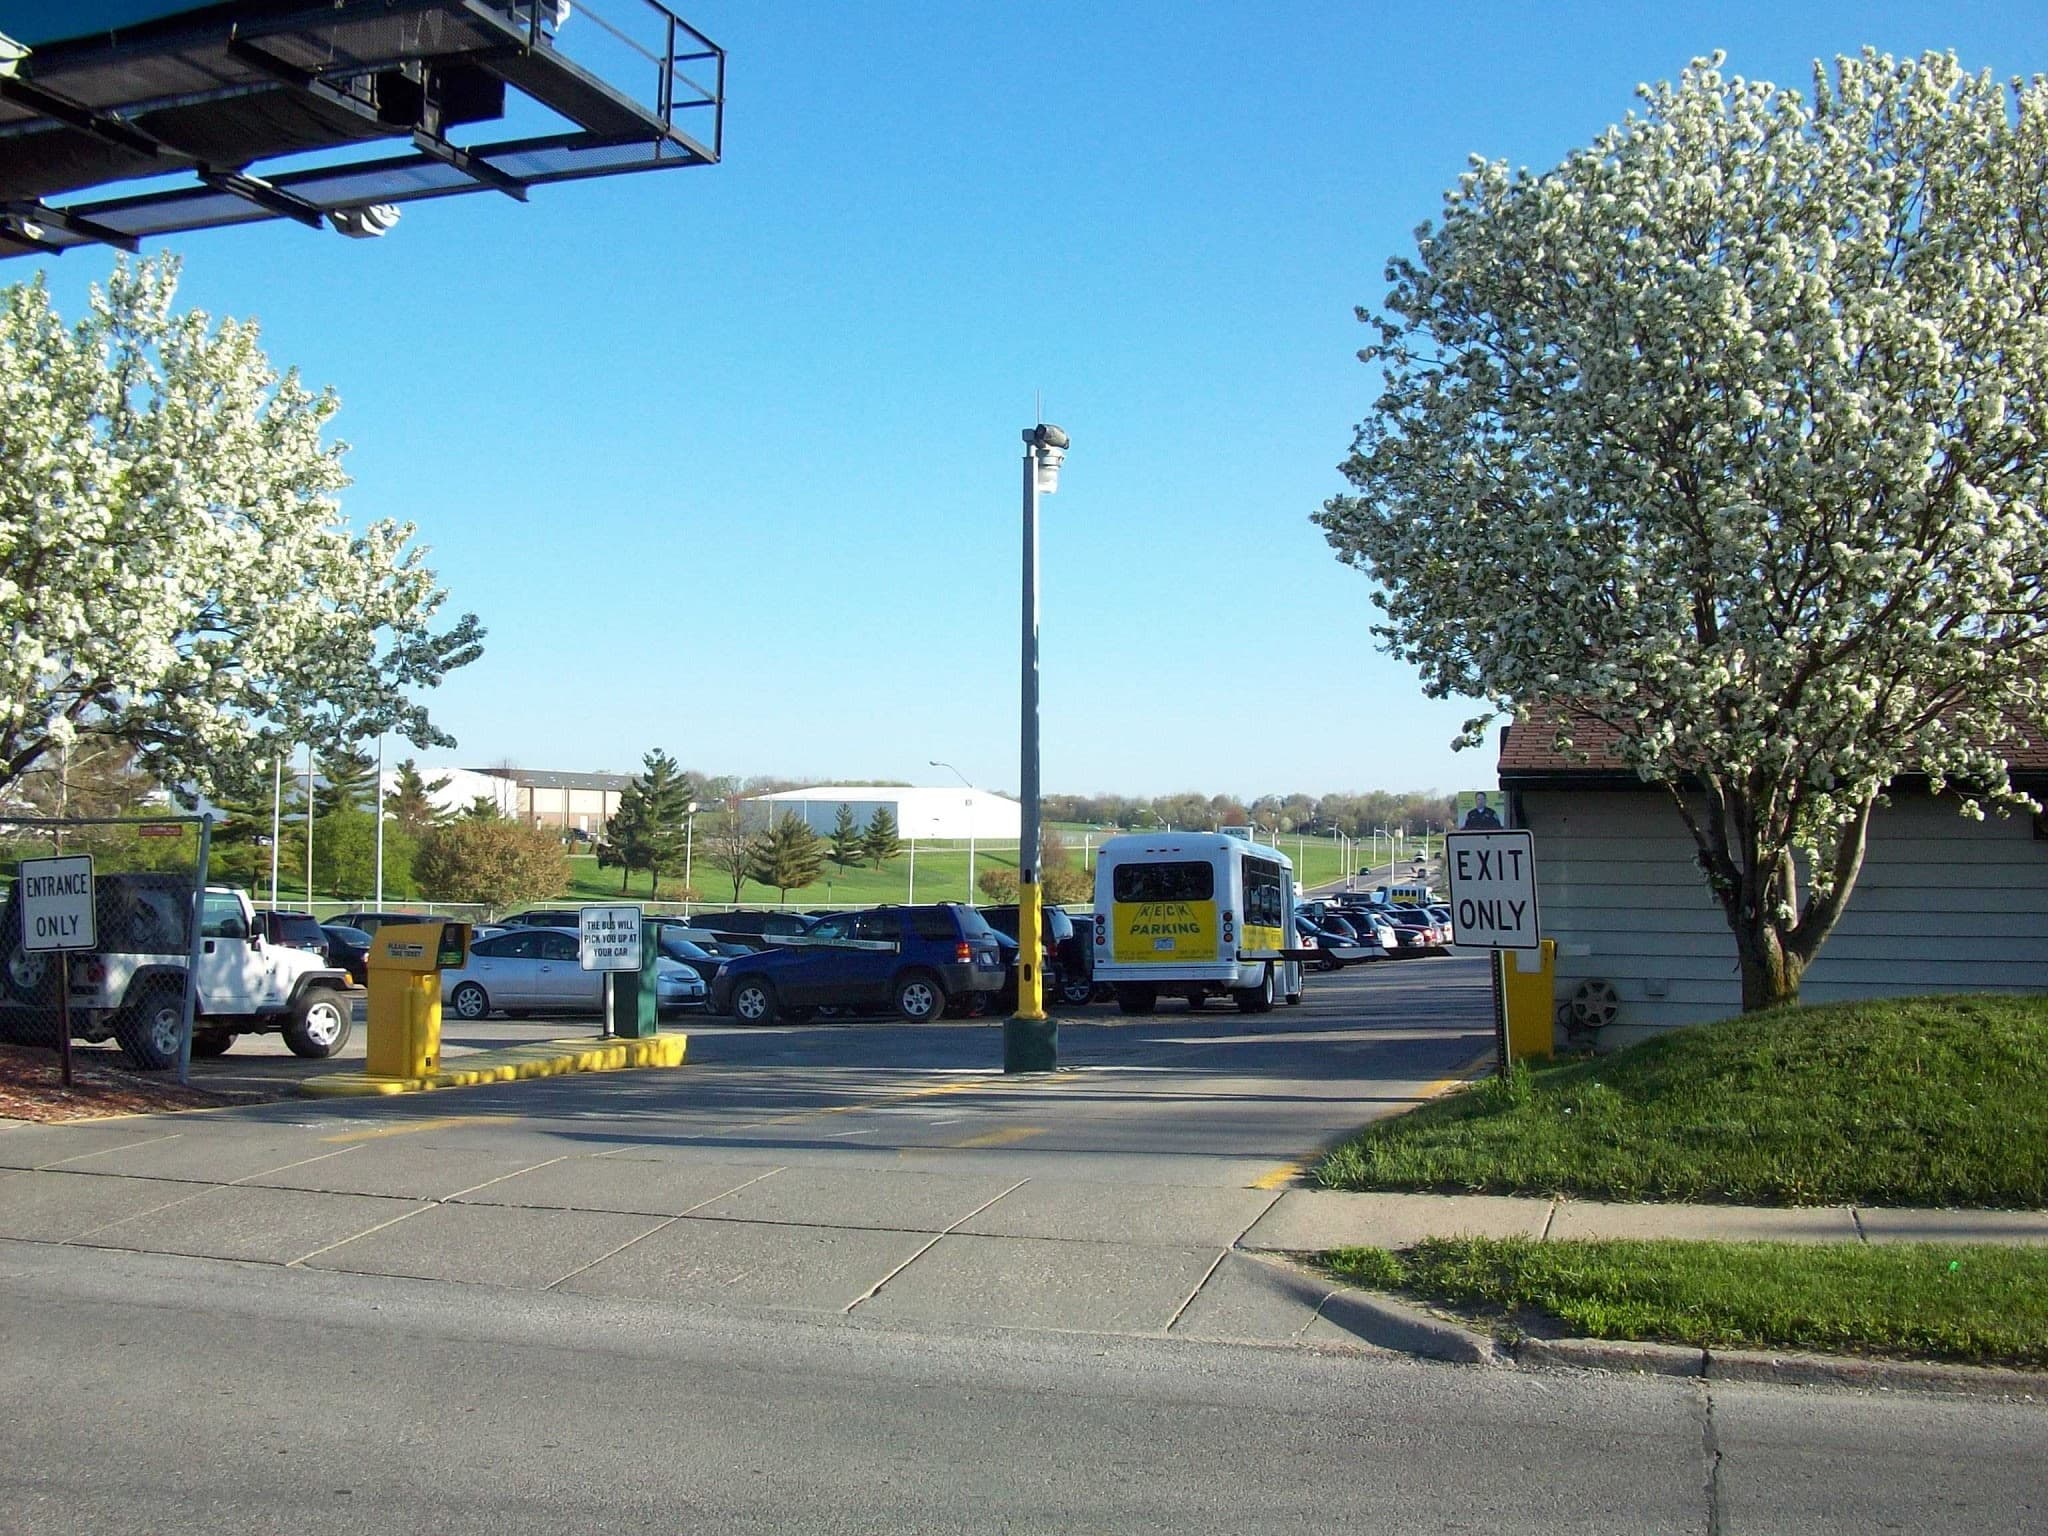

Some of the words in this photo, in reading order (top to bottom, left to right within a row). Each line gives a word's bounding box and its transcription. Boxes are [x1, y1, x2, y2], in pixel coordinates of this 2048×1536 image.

[1457, 850, 1523, 881] EXIT
[26, 873, 88, 898] ENTRANCE
[1140, 904, 1189, 917] KECK
[1459, 899, 1527, 931] ONLY
[36, 914, 79, 937] ONLY
[587, 920, 600, 930] THE
[602, 920, 616, 930] BUS
[617, 920, 634, 930] WILL
[1130, 922, 1200, 935] PARKING
[584, 934, 600, 944] PICK
[602, 934, 617, 944] YOU
[618, 934, 628, 943] UP
[629, 934, 637, 943] AT
[593, 947, 612, 957] YOUR
[614, 947, 628, 957] CAR
